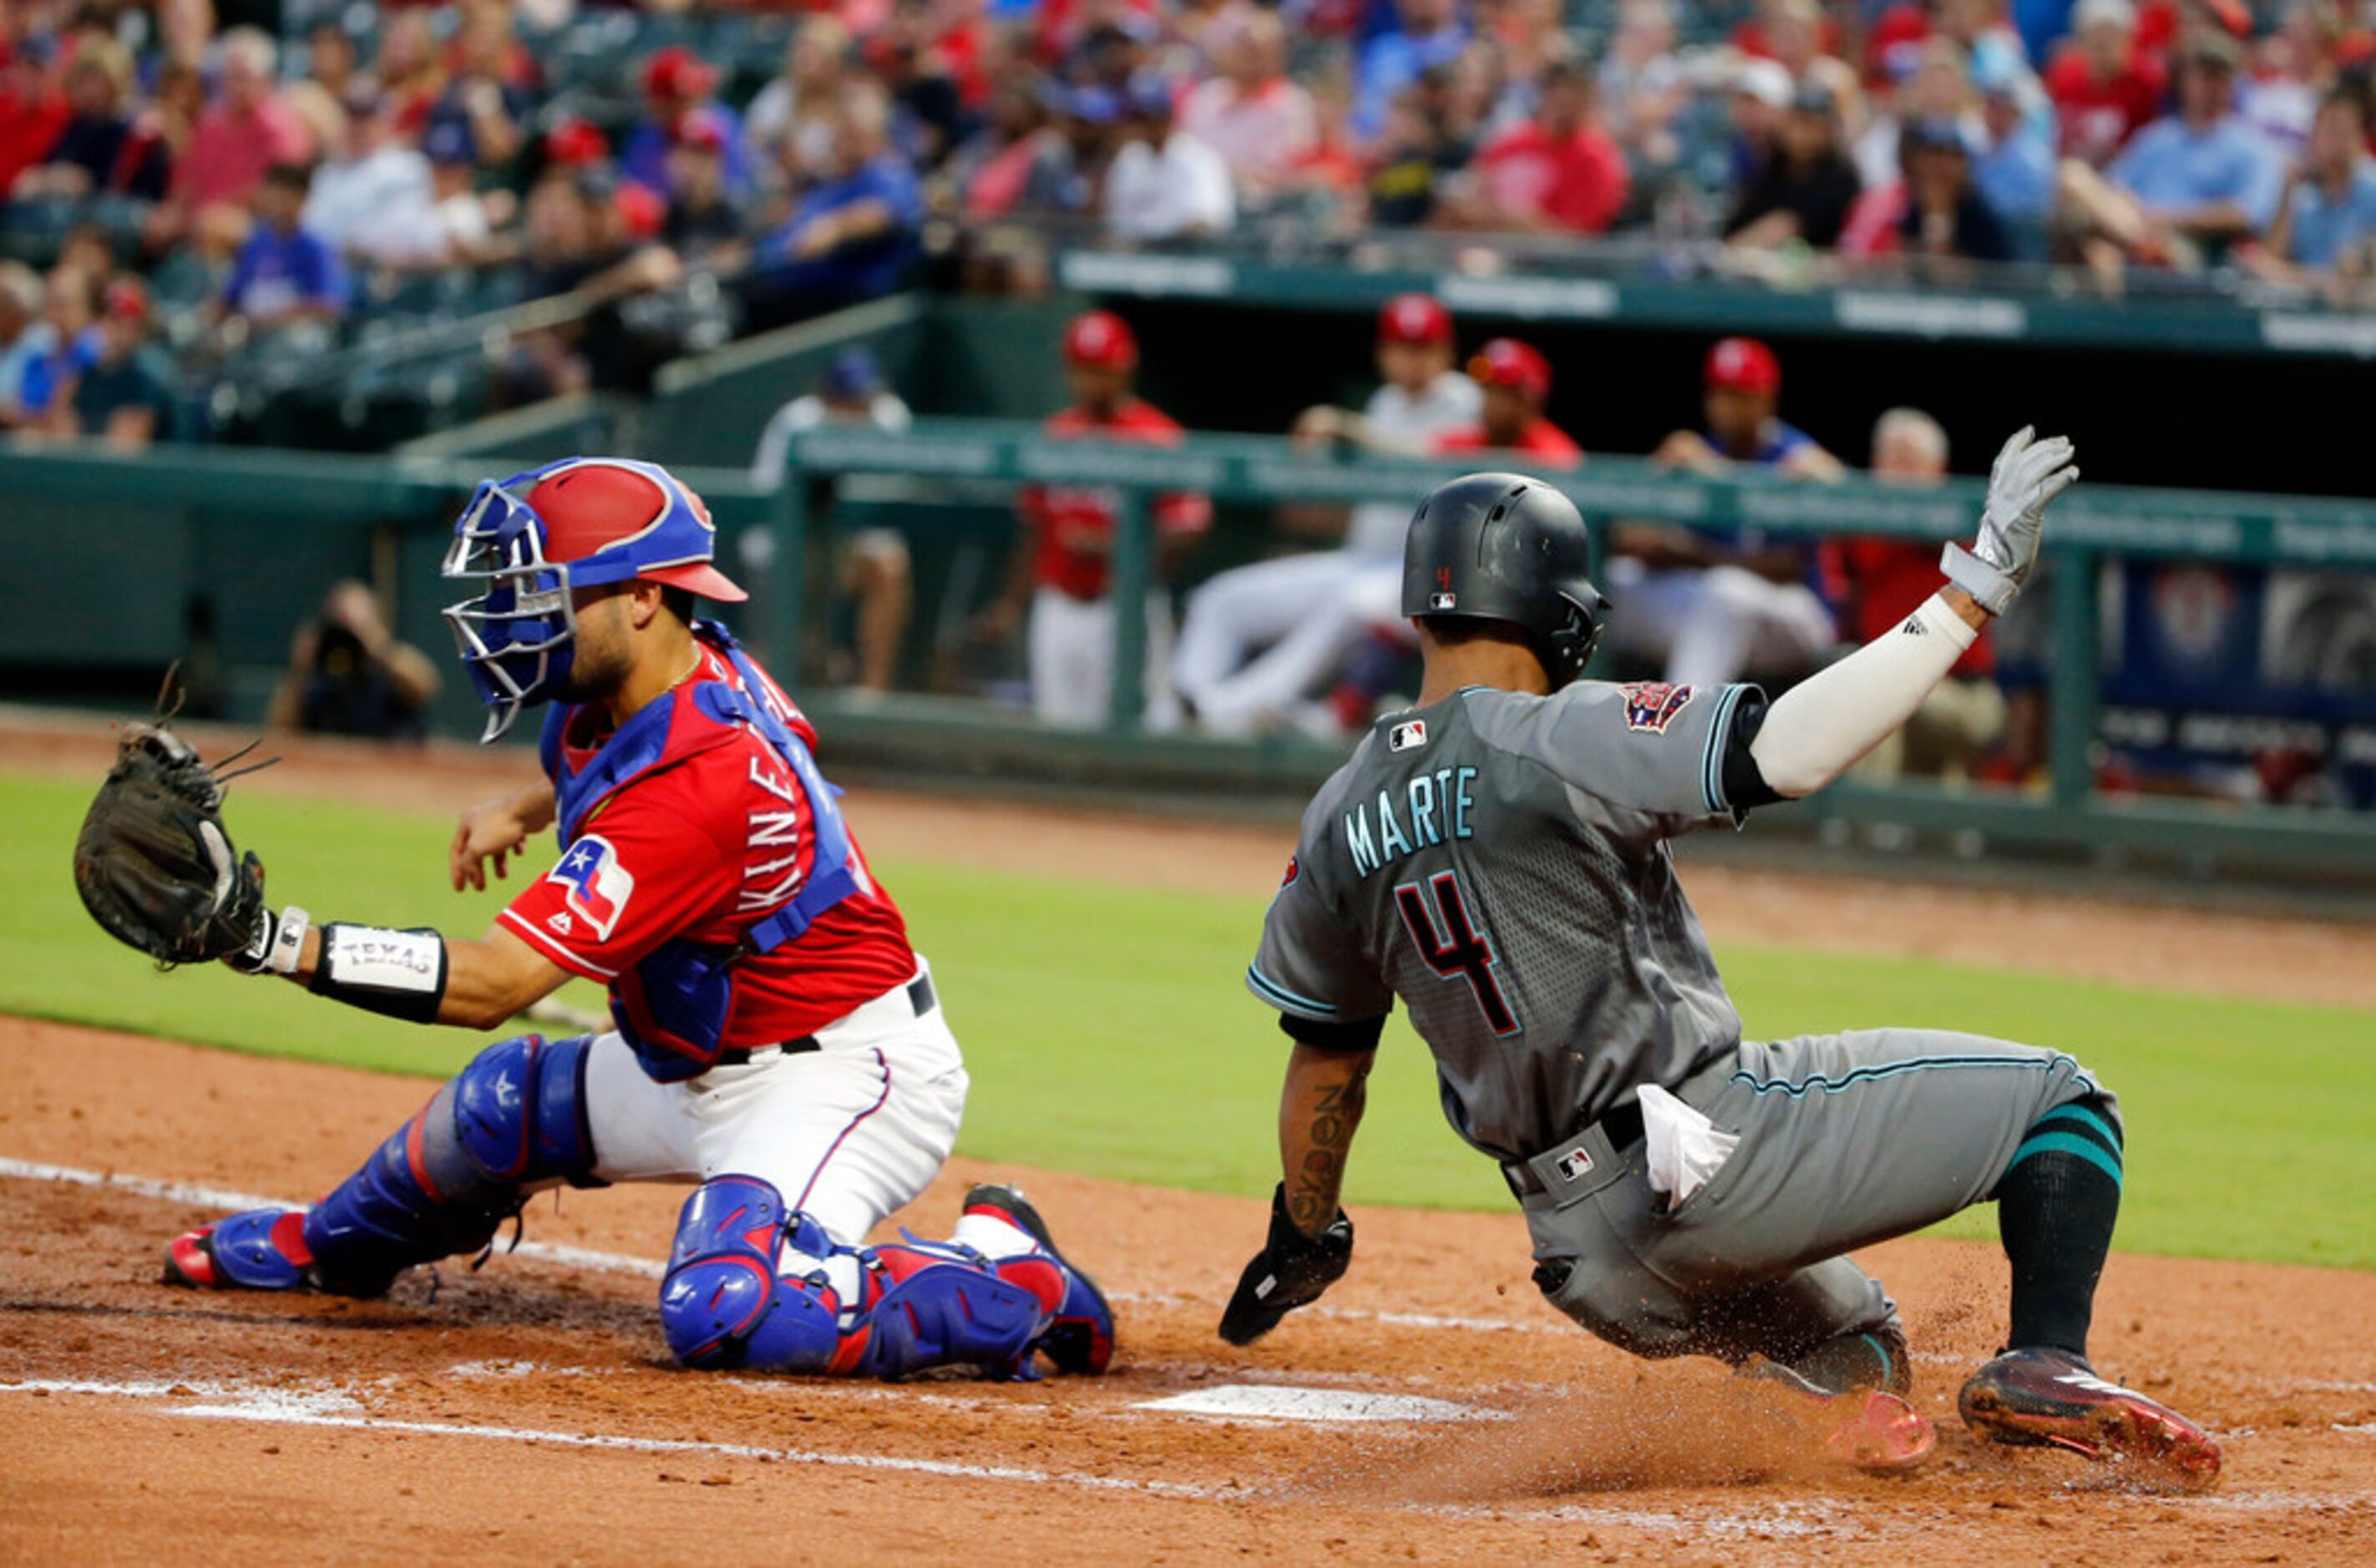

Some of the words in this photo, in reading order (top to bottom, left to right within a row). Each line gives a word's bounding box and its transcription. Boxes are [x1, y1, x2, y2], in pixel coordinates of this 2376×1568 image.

[1436, 565, 1451, 592] 4
[1345, 767, 1477, 878] MARTE
[1393, 870, 1522, 1038] 4
